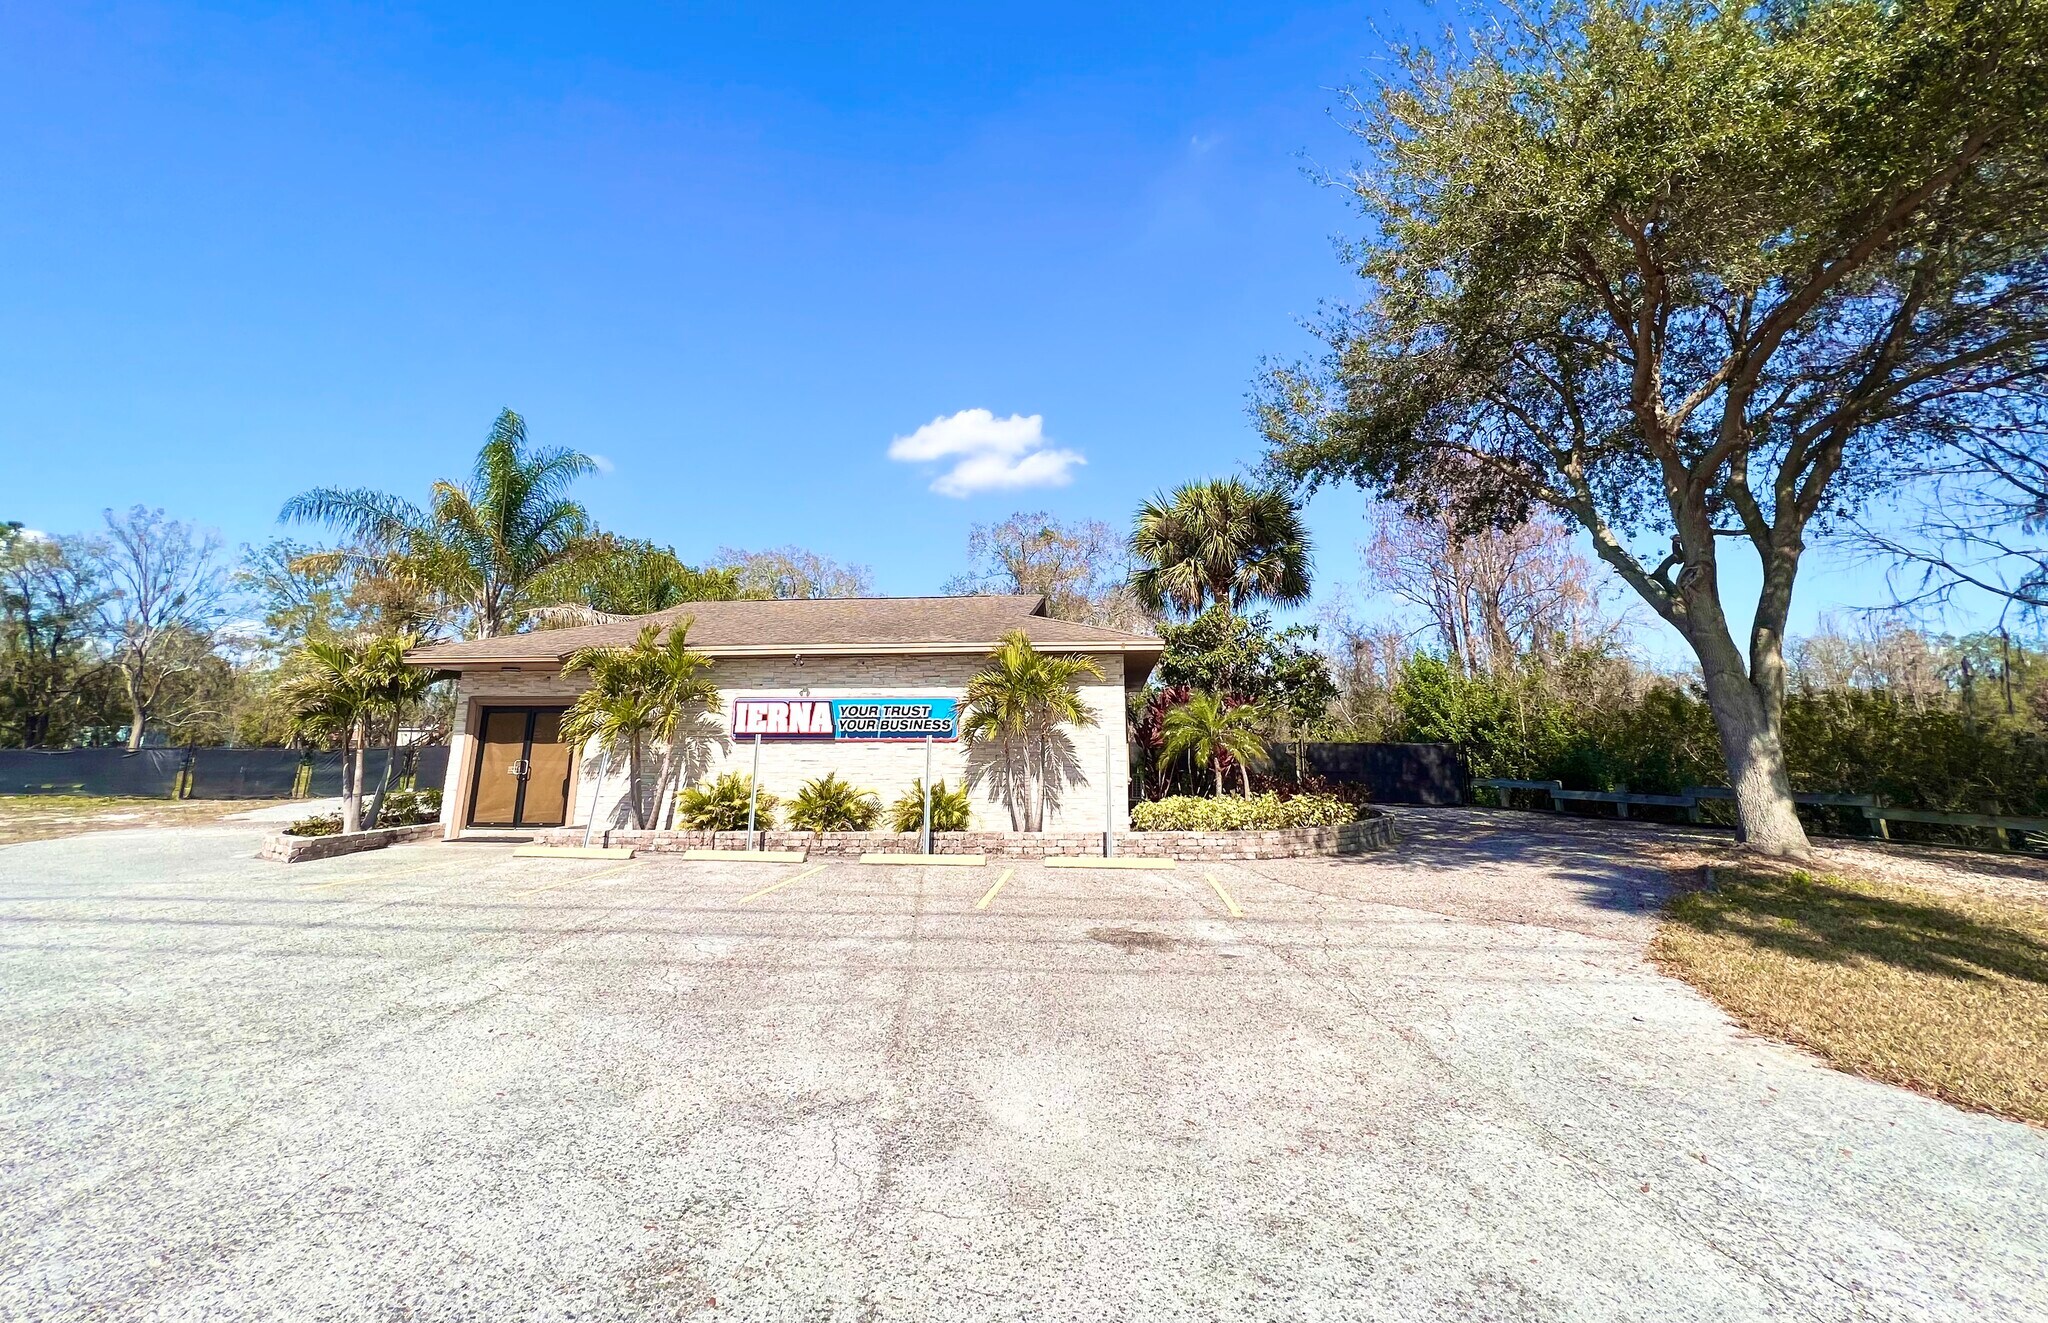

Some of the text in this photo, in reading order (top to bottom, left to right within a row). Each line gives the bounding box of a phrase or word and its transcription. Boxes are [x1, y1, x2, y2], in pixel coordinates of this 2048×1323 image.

[840, 705, 931, 717] YOUR TRUST
[734, 702, 833, 733] IERNA
[838, 719, 952, 731] YOUR BUSINESS
